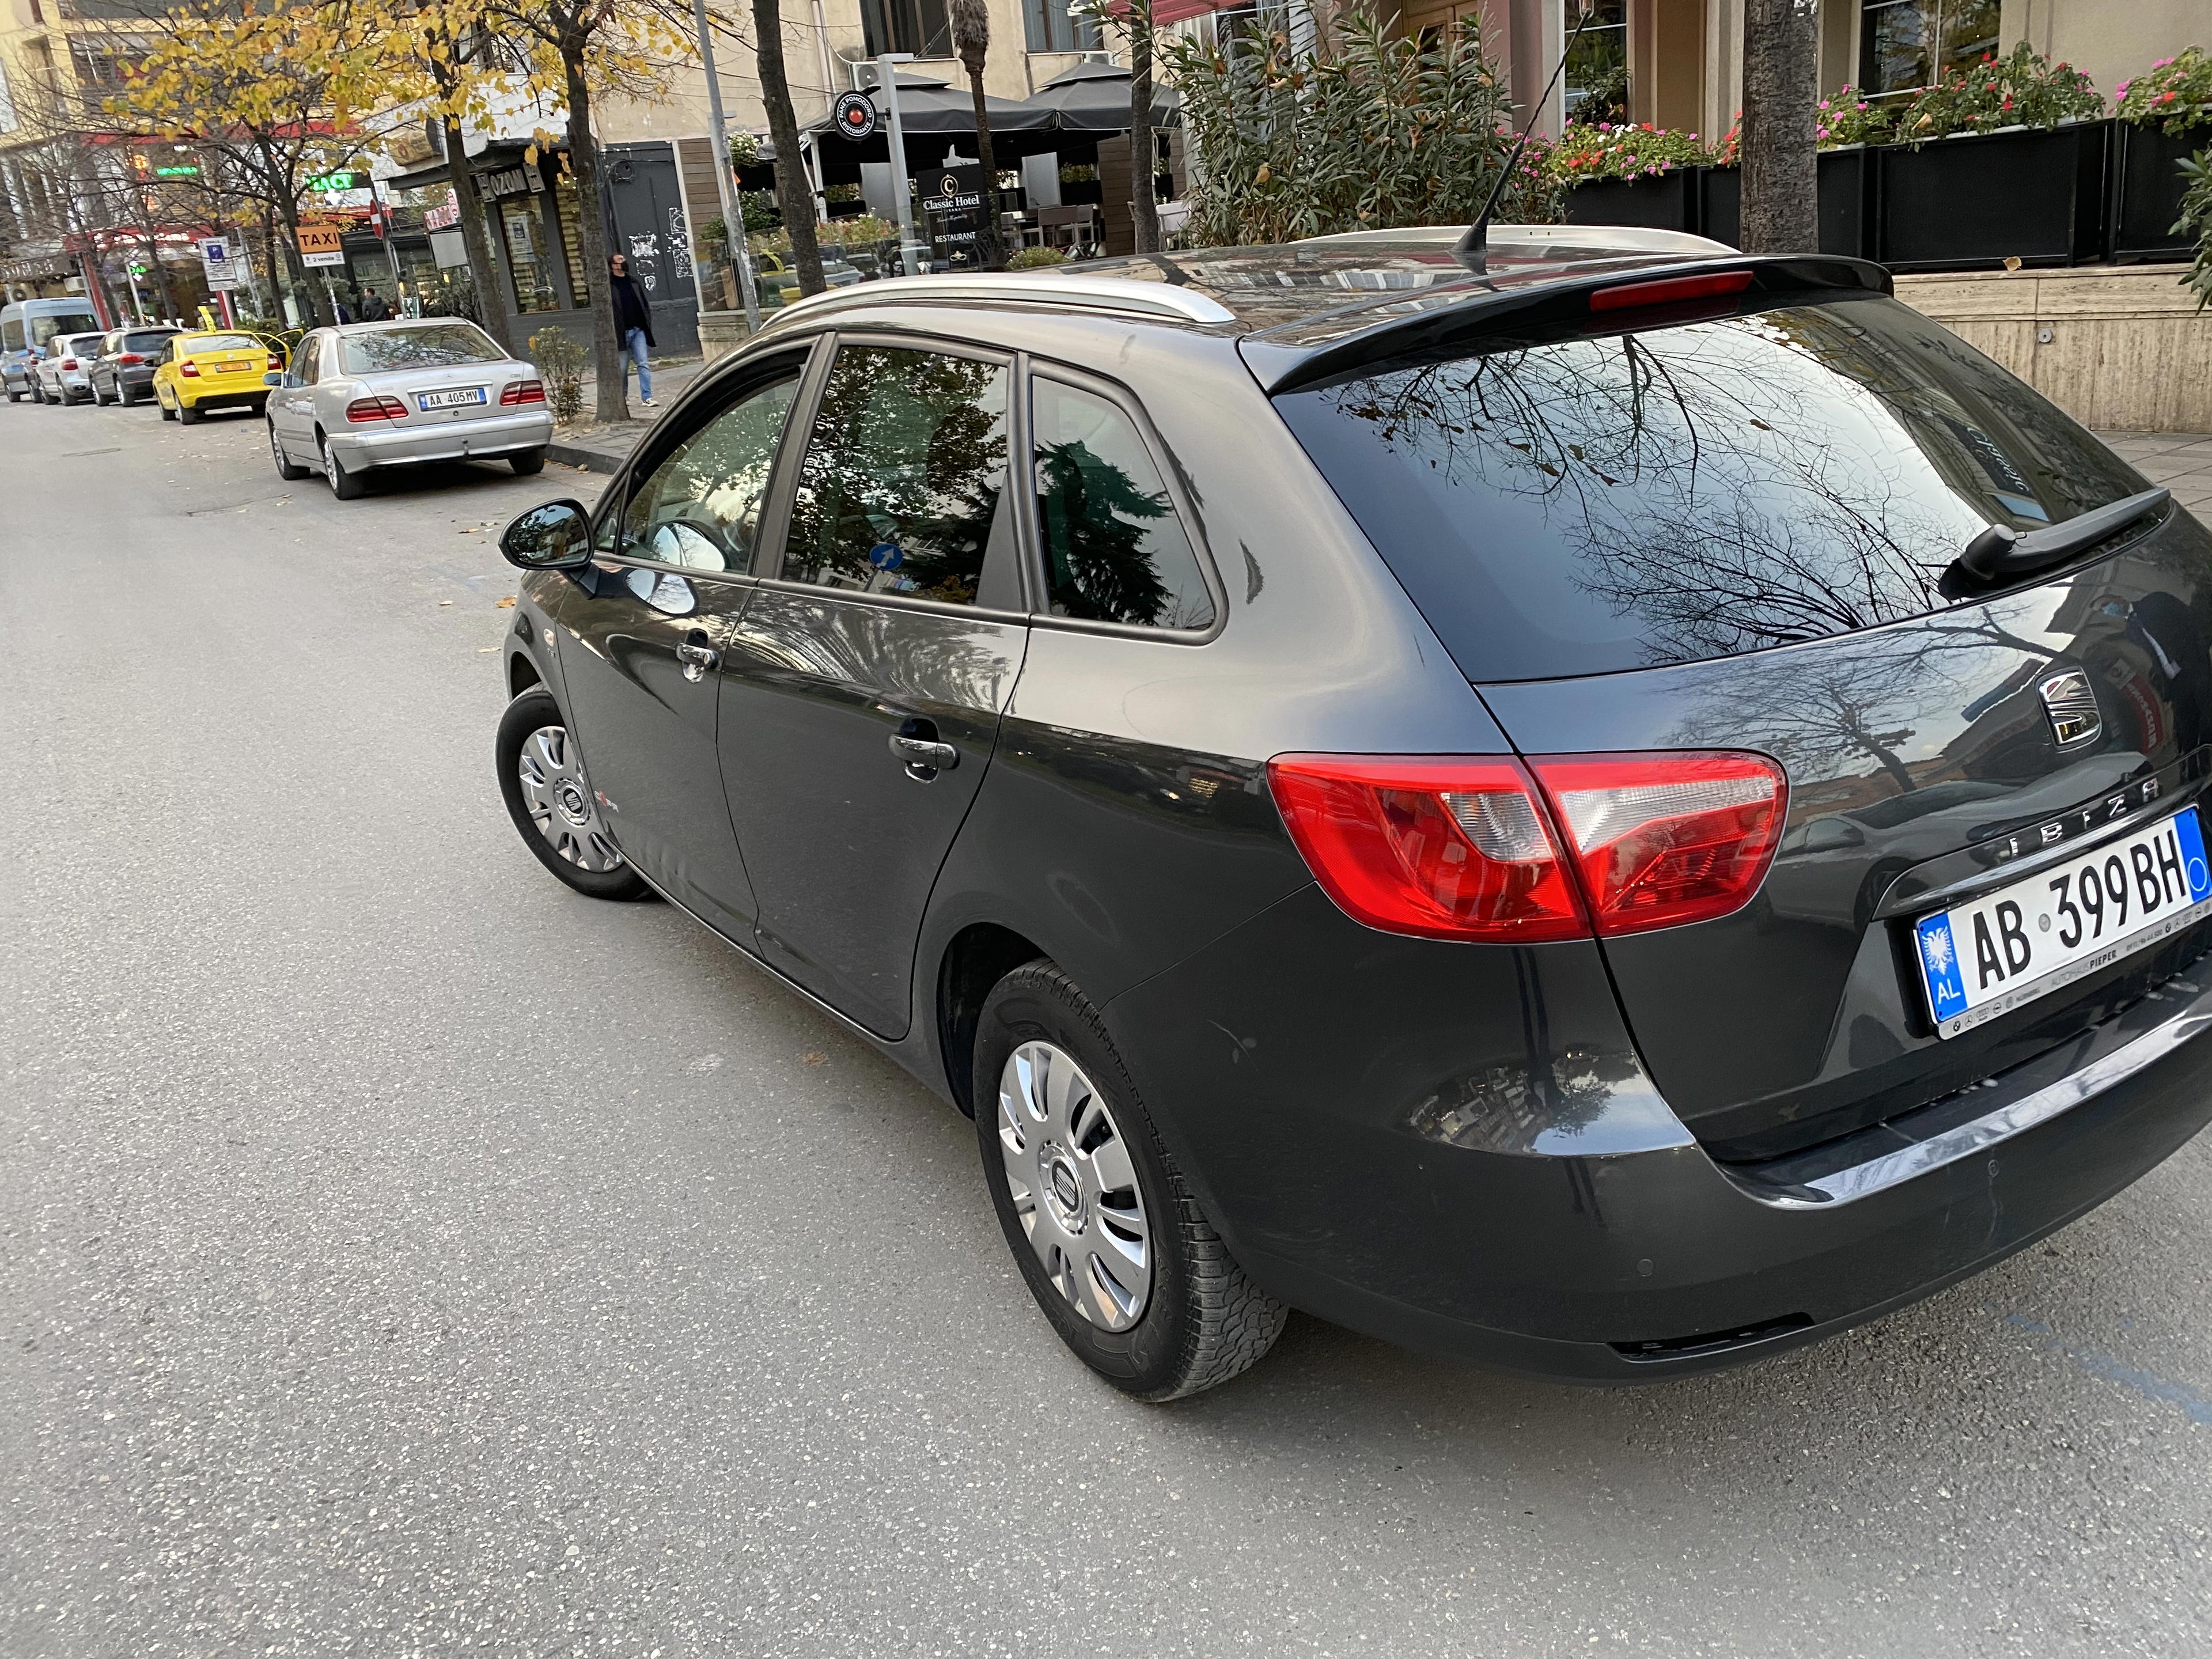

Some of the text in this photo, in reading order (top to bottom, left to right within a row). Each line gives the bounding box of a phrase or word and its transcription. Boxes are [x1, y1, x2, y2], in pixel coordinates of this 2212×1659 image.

[845, 96, 872, 118] POMODORO
[842, 121, 871, 134] RISTORANTE
[944, 179, 954, 192] C
[923, 194, 980, 210] Classic Hotel
[300, 232, 338, 246] TAXI
[935, 232, 976, 243] RESTAURANT
[430, 395, 442, 406] AA
[1972, 900, 2031, 990] AB
[2089, 950, 2117, 969] PIEPER
[1938, 978, 1961, 1005] AL
